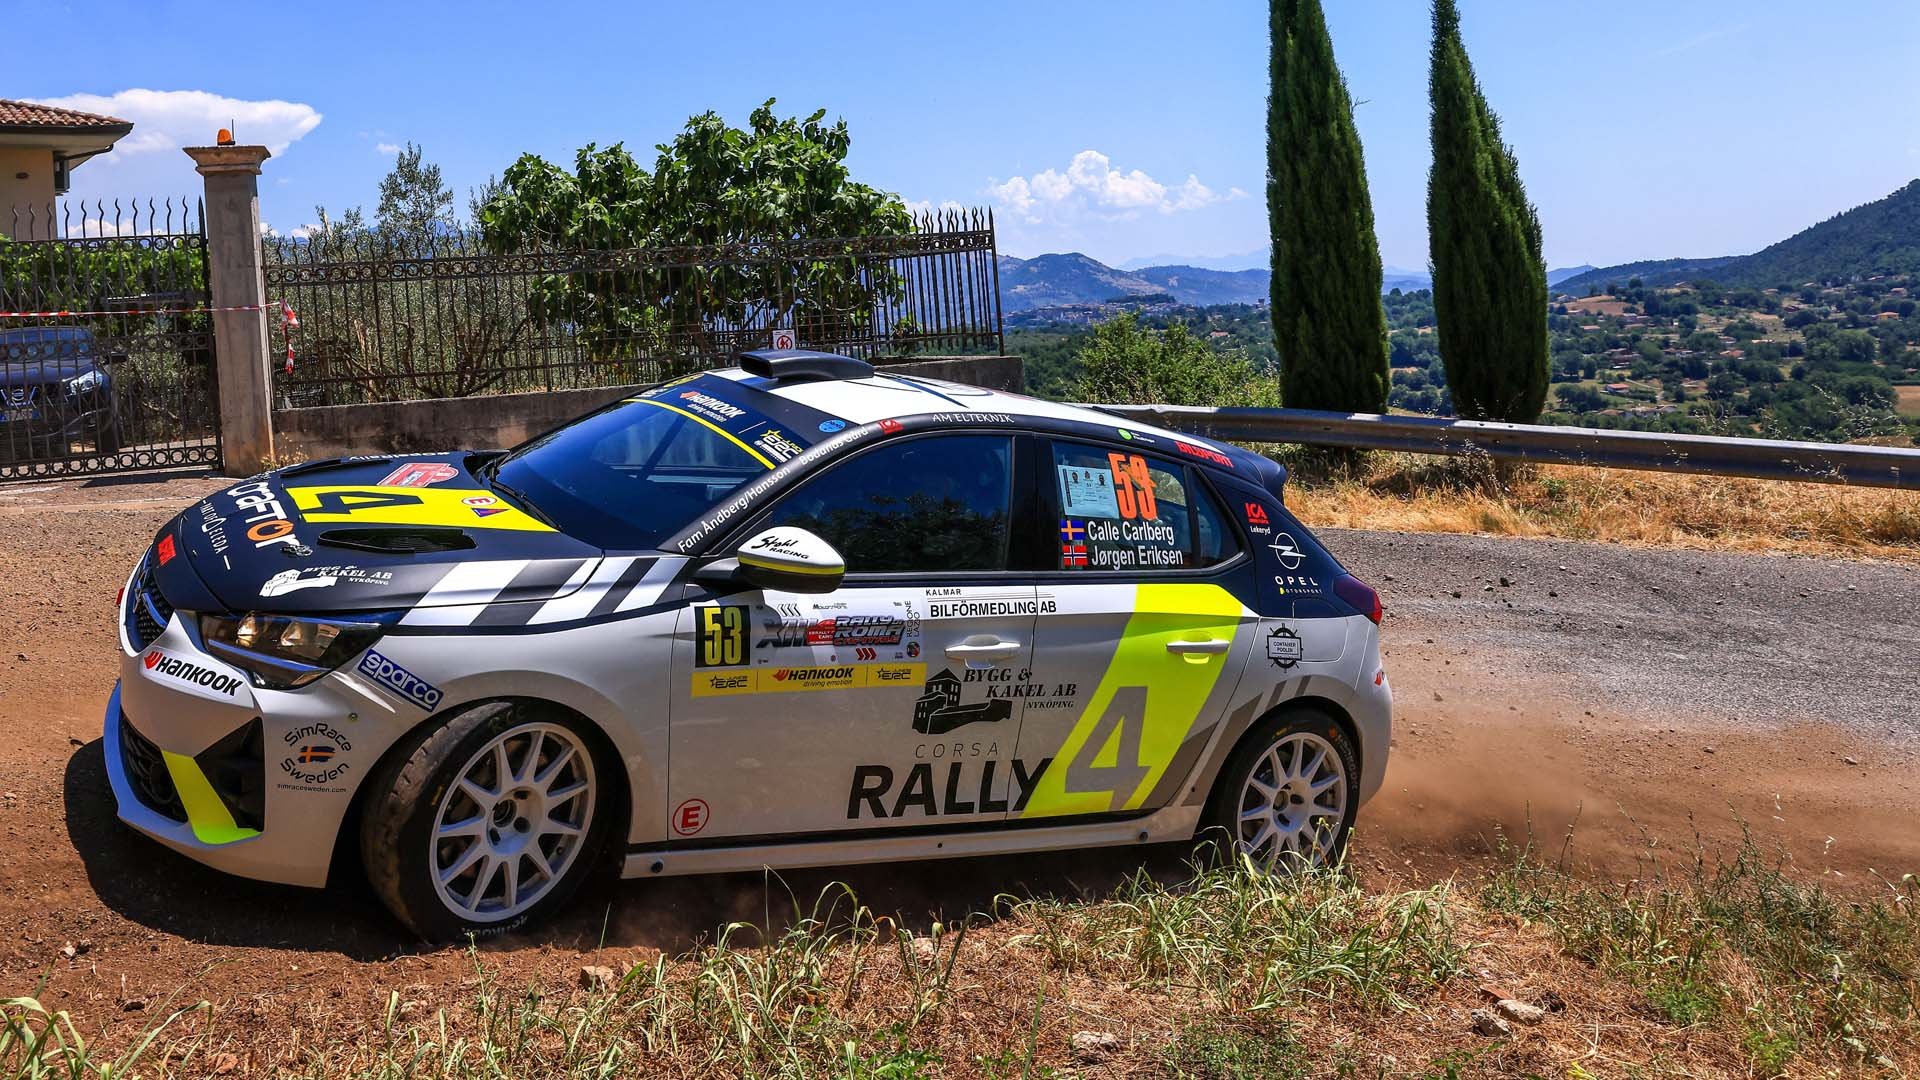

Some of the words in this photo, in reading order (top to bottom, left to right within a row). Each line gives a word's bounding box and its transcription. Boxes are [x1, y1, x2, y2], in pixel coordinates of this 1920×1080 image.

[932, 413, 952, 423] AM
[955, 413, 1015, 423] ELTEKNIK
[1108, 453, 1157, 520] 53
[1245, 502, 1268, 519] ICA
[677, 530, 704, 552] Fam
[1087, 520, 1120, 541] Calle
[1122, 520, 1175, 546] Carlberg
[769, 547, 809, 559] RACING
[1091, 545, 1136, 571] Jørgen
[1138, 545, 1184, 565] Eriksen
[370, 571, 393, 580] AB
[1274, 575, 1319, 586] OPEL
[925, 588, 962, 596] KALMAR
[905, 600, 914, 638] REGIONE
[930, 600, 1037, 618] BILFÖRMEDLING
[1040, 600, 1057, 614] AB
[833, 625, 905, 638] ROMA
[912, 611, 921, 638] LAZIO
[703, 606, 743, 666] 53
[365, 653, 440, 704] sparco
[964, 668, 1011, 683] BYGG
[1017, 668, 1033, 682] &
[985, 684, 1046, 698] KAKEL
[1052, 683, 1077, 697] AB
[284, 723, 352, 752] SimRace
[847, 757, 1055, 820] RALLY
[1064, 686, 1153, 812] 4
[915, 742, 999, 759] CORSA
[280, 758, 350, 784] Sweden
[681, 805, 702, 829] E
